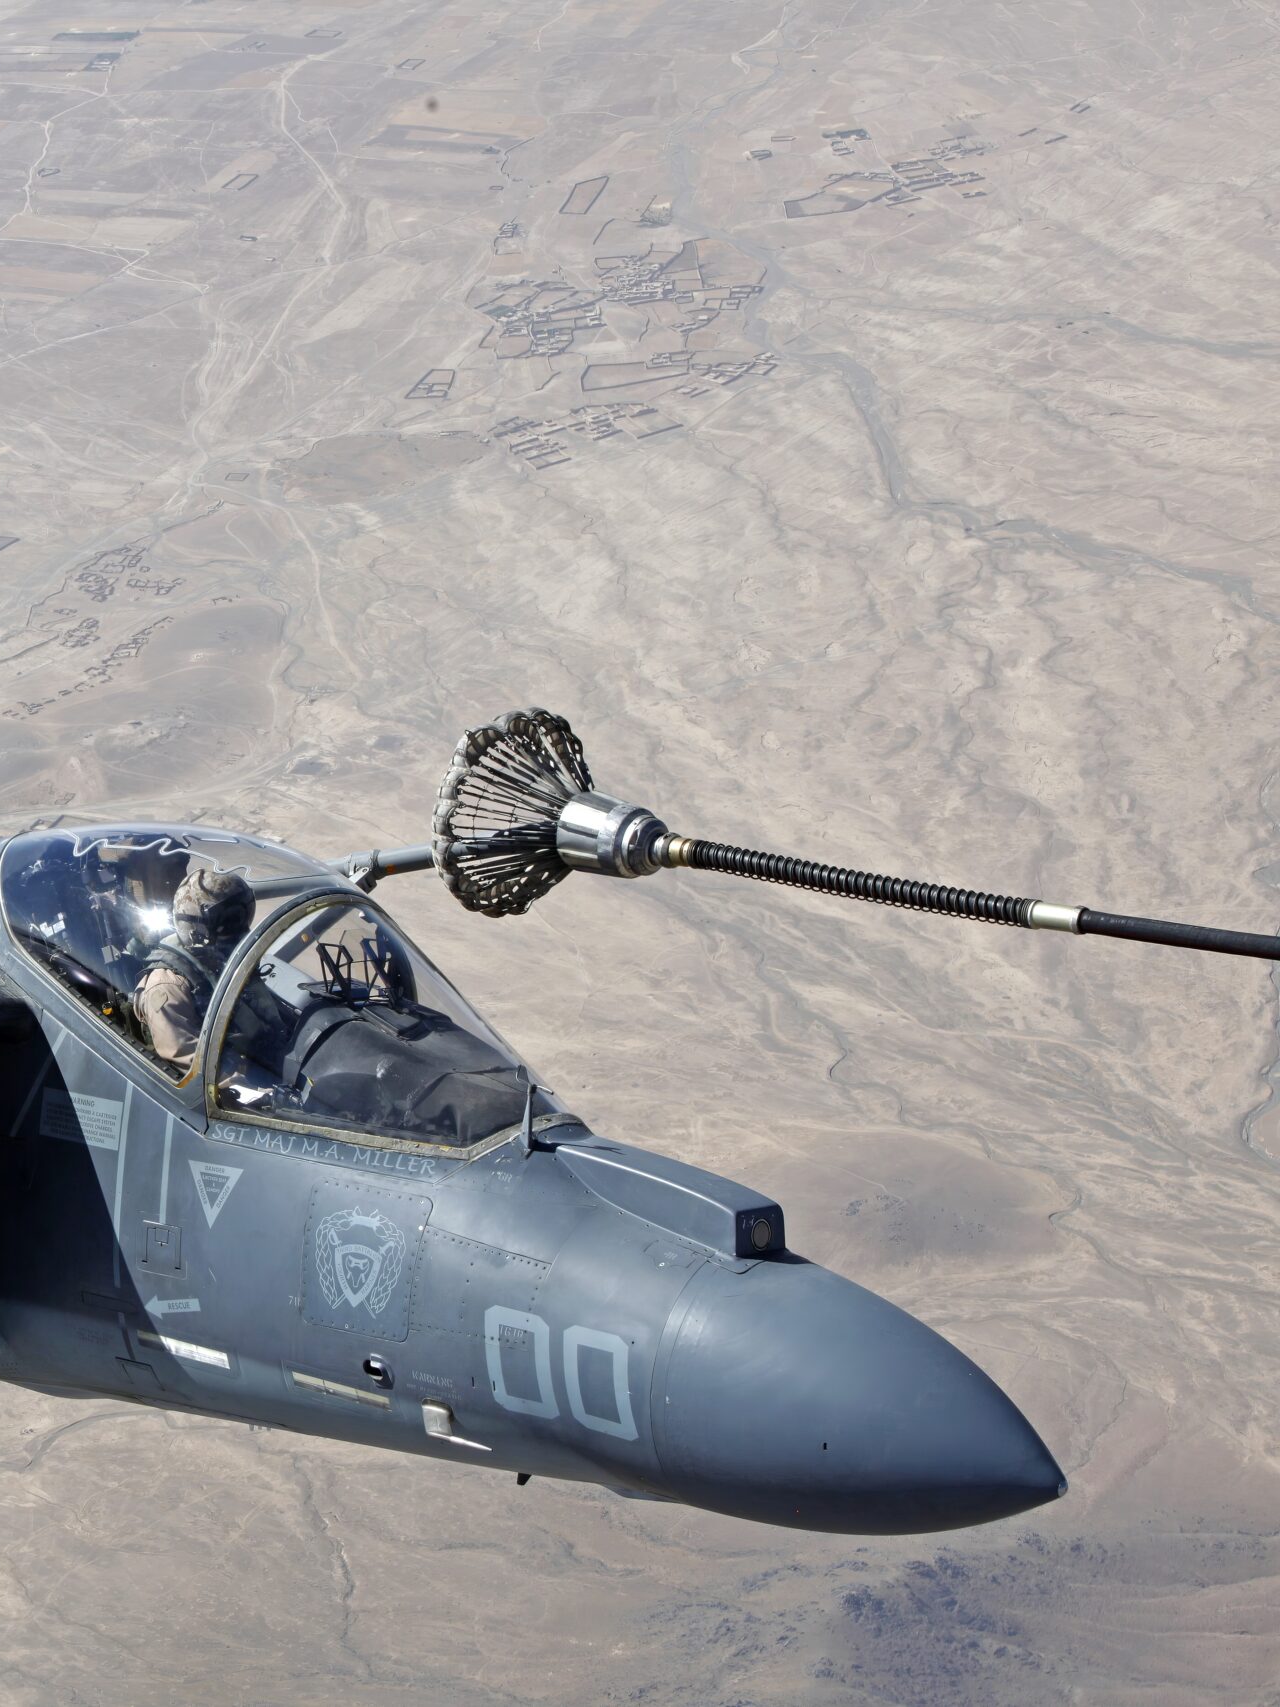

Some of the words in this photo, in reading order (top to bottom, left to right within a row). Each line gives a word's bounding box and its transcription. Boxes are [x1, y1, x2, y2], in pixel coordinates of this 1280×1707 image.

[212, 1122, 249, 1143] SGT
[253, 1129, 296, 1154] MAJ
[302, 1137, 345, 1160] M.A.
[353, 1146, 436, 1175] MILLER
[167, 1301, 191, 1310] RESCUE
[484, 1304, 639, 1441] 00
